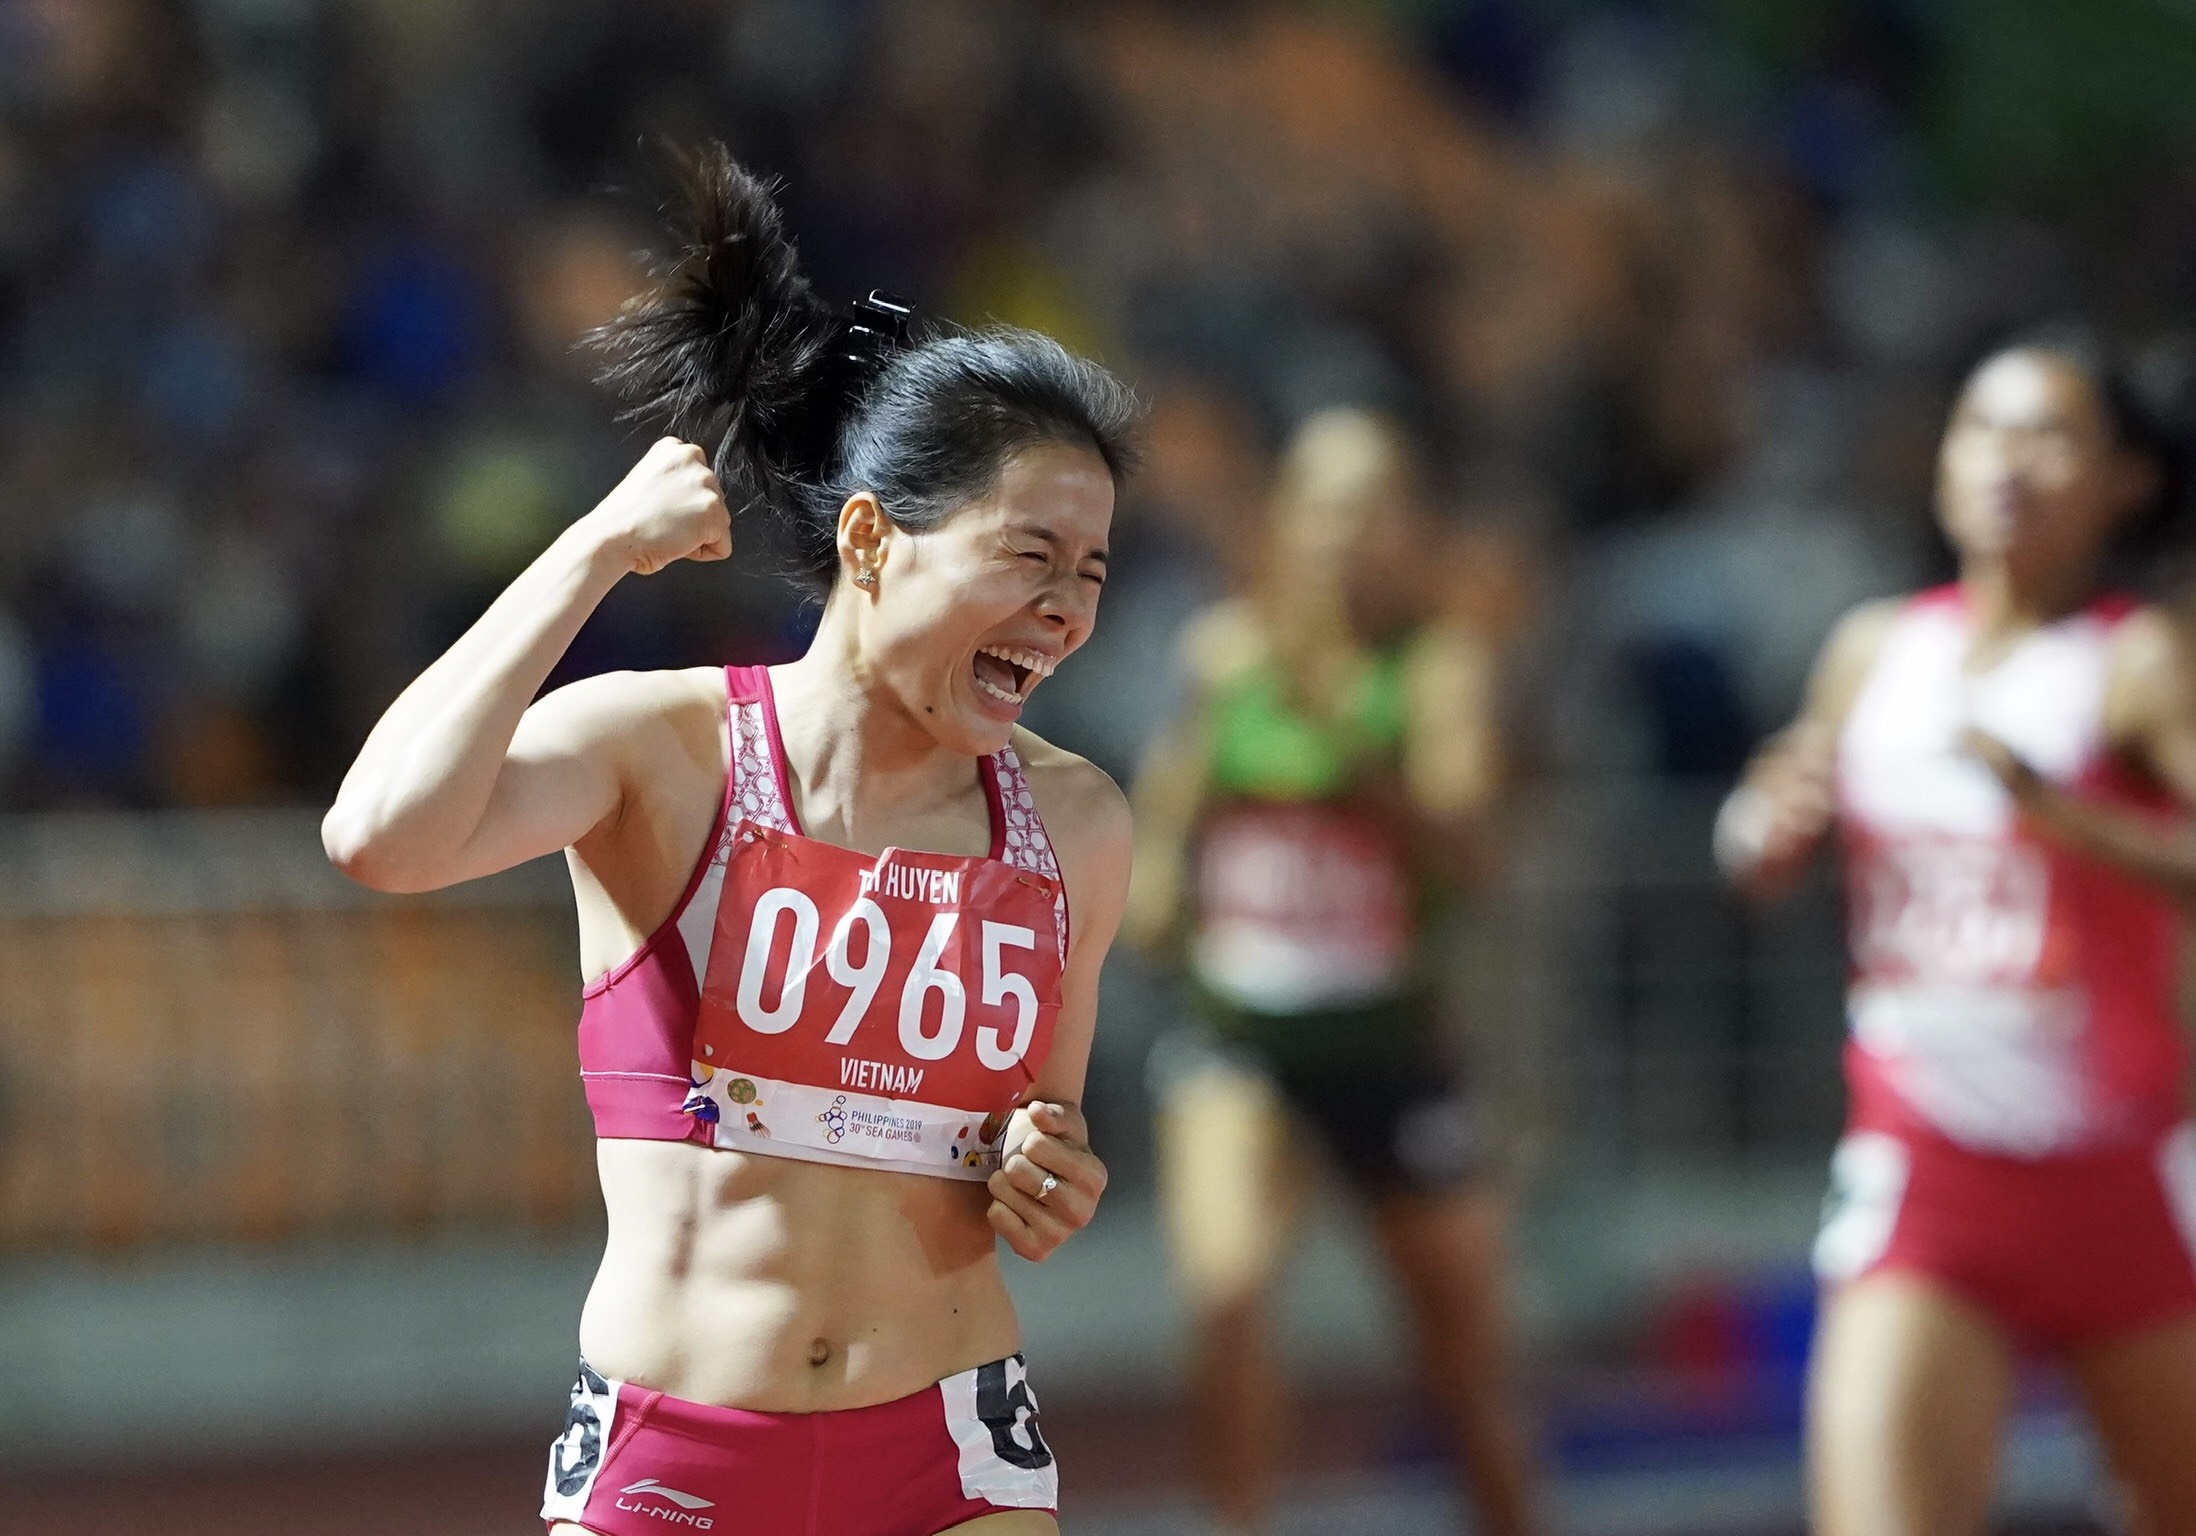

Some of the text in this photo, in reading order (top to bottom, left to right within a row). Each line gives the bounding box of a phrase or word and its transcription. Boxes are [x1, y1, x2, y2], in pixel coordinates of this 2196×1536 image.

[885, 862, 960, 904] HUYEN
[736, 886, 1039, 1071] 0965
[840, 1057, 924, 1094] VIETNAM
[851, 1110, 922, 1131] PHILIPPINES 2019
[865, 1124, 884, 1138] SEA
[885, 1128, 914, 1142] GAMES
[615, 1497, 714, 1530] LI-NING
